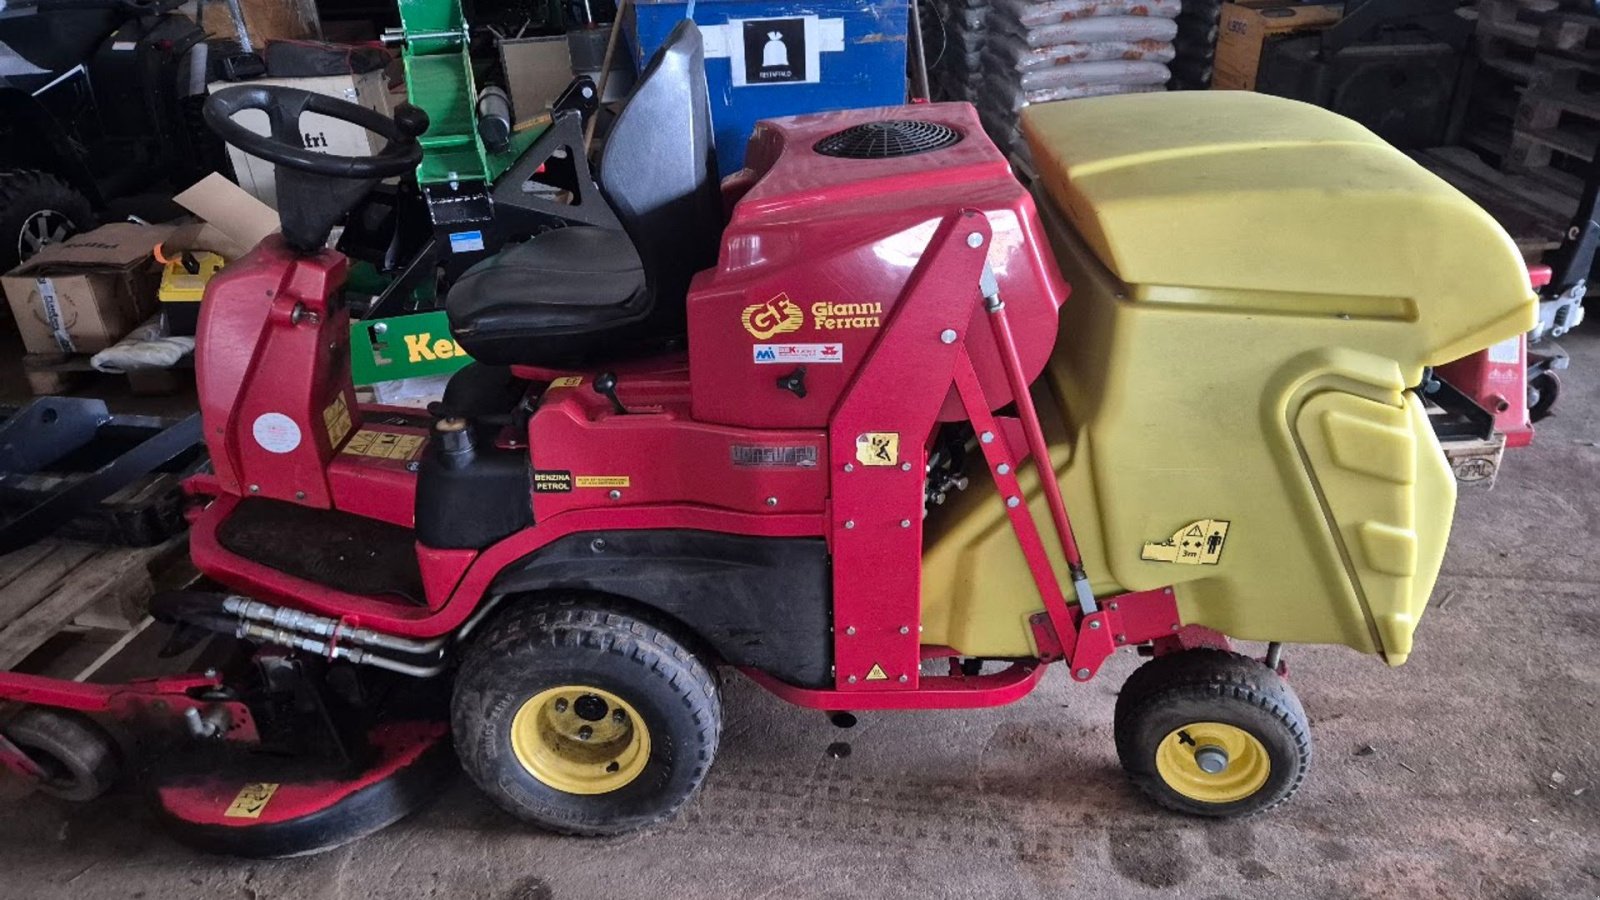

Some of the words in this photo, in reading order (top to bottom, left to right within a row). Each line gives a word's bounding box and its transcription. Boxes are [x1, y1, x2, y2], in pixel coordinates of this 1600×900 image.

[303, 132, 328, 148] fri
[811, 301, 882, 316] Gianni
[814, 315, 880, 330] Ferrari
[534, 473, 570, 481] BENZINA
[536, 482, 570, 490] PETROL
